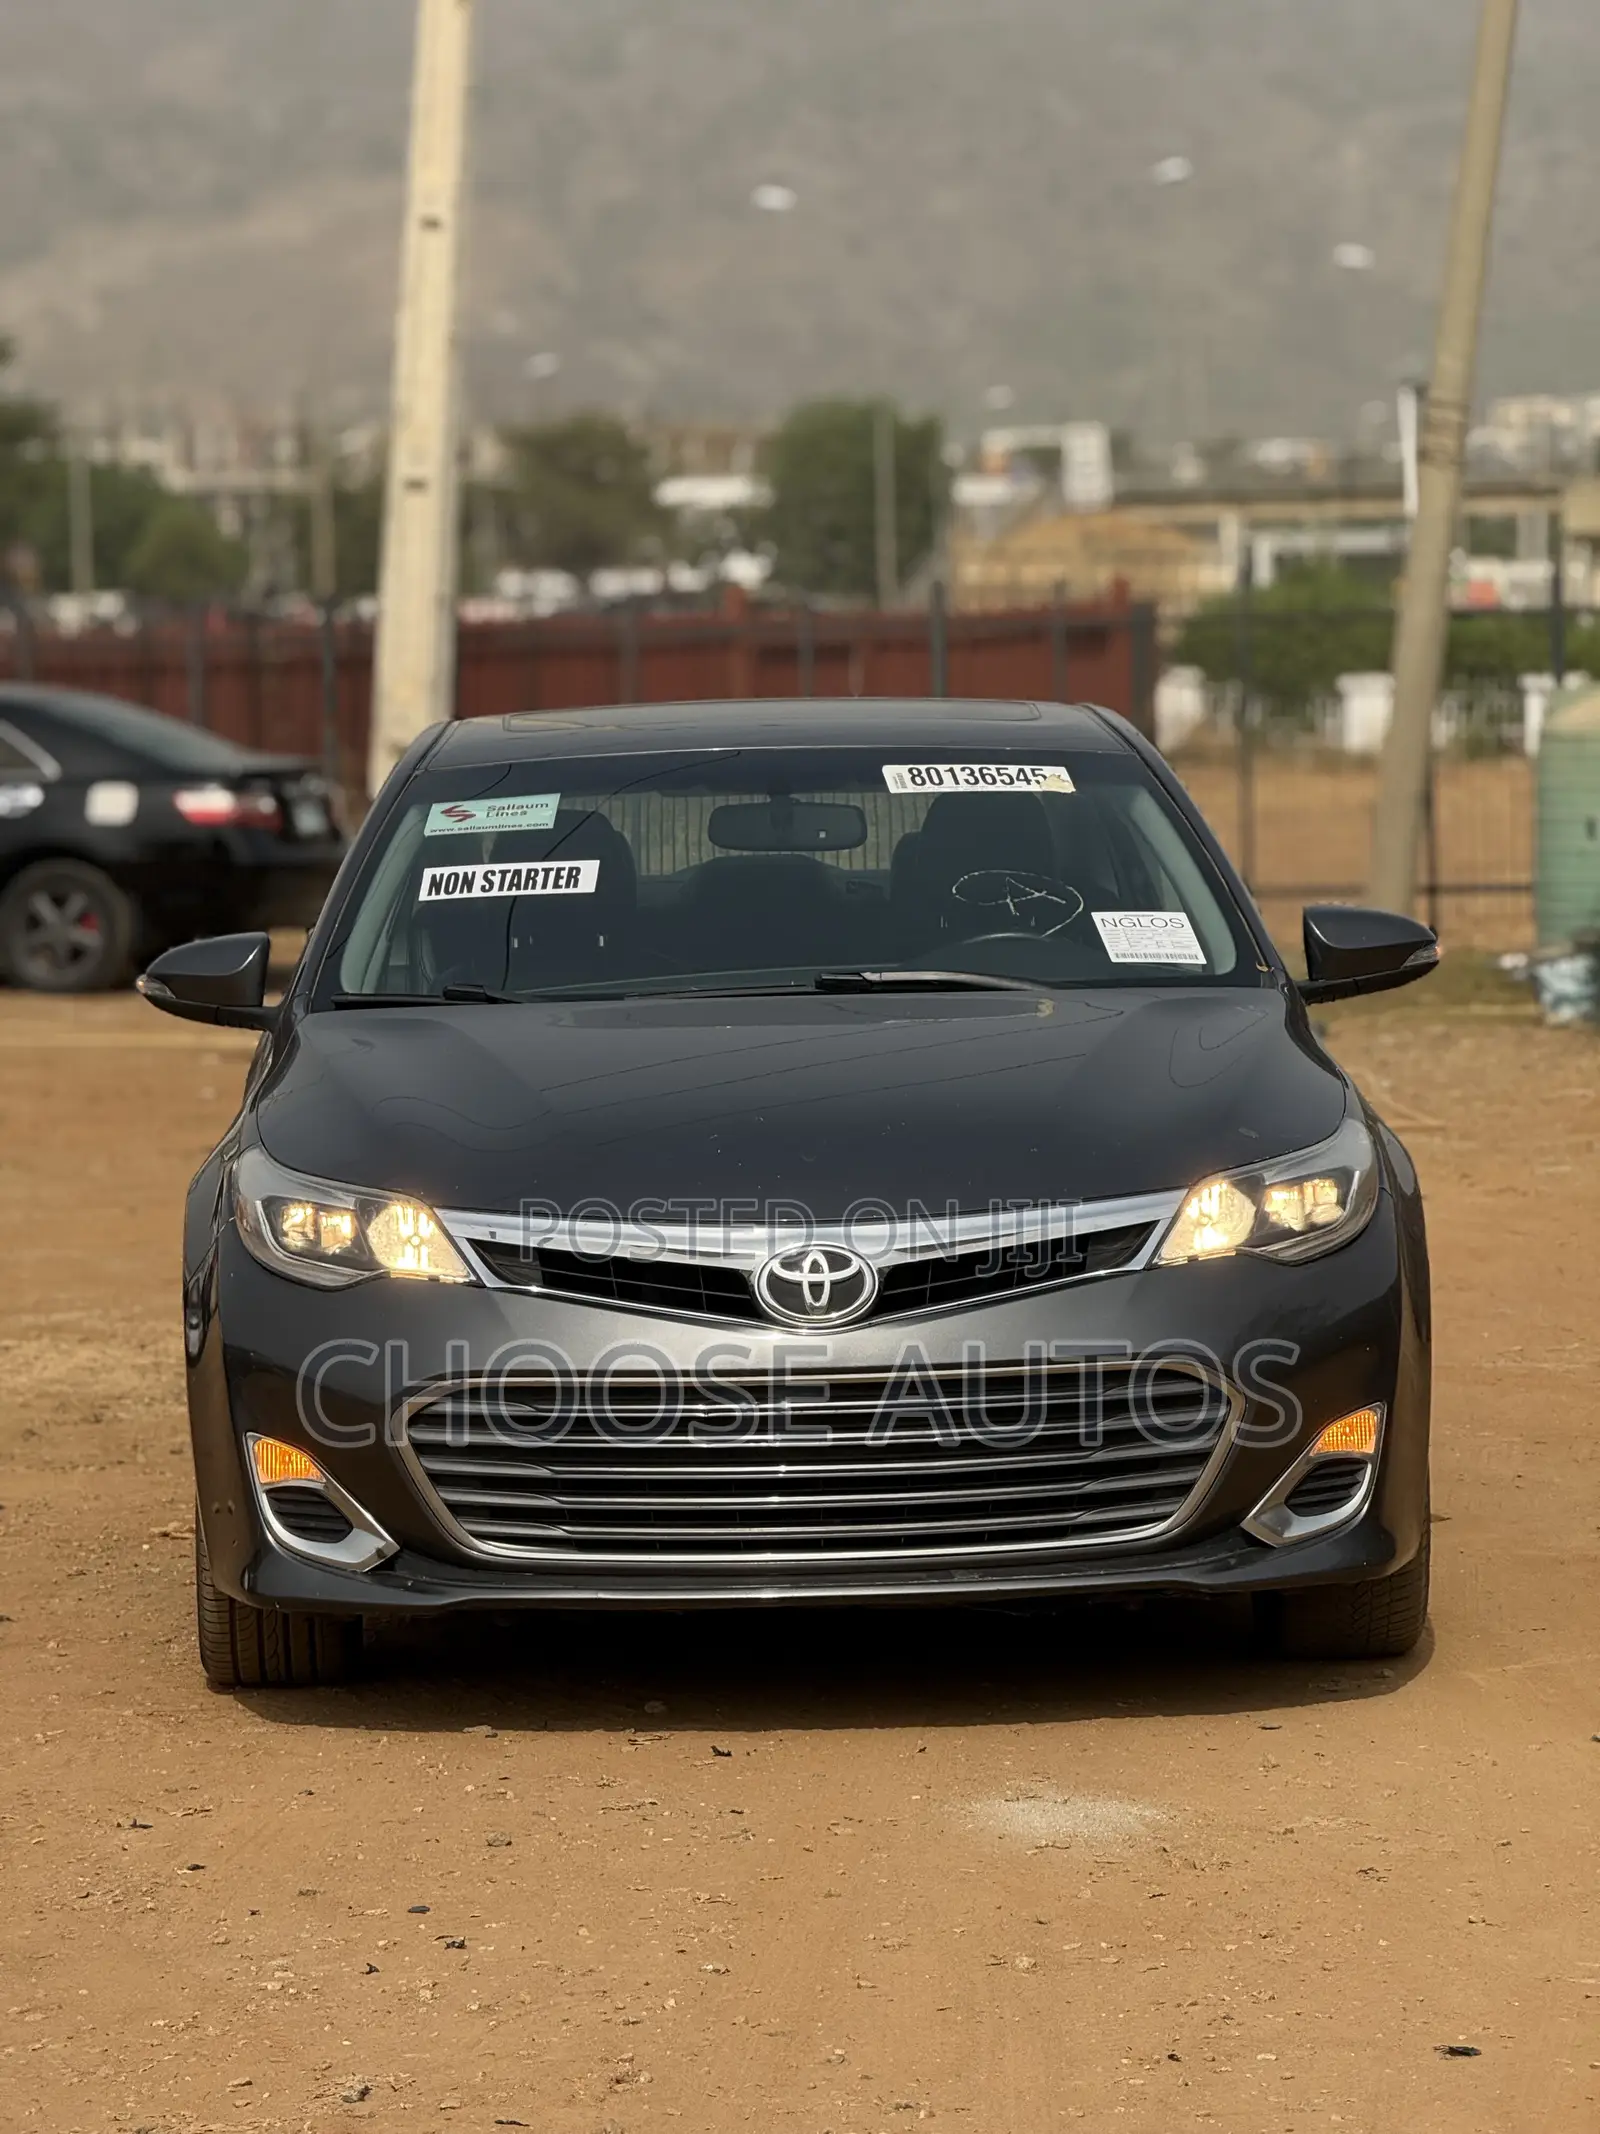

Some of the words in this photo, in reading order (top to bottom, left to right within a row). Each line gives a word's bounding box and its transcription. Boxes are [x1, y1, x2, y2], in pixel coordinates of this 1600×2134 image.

[907, 766, 1047, 787] 80136545
[486, 802, 550, 812] Sallaum
[485, 810, 528, 818] Lines
[427, 871, 476, 896] NON
[480, 866, 581, 893] STARTER
[1100, 917, 1185, 929] NGLOS
